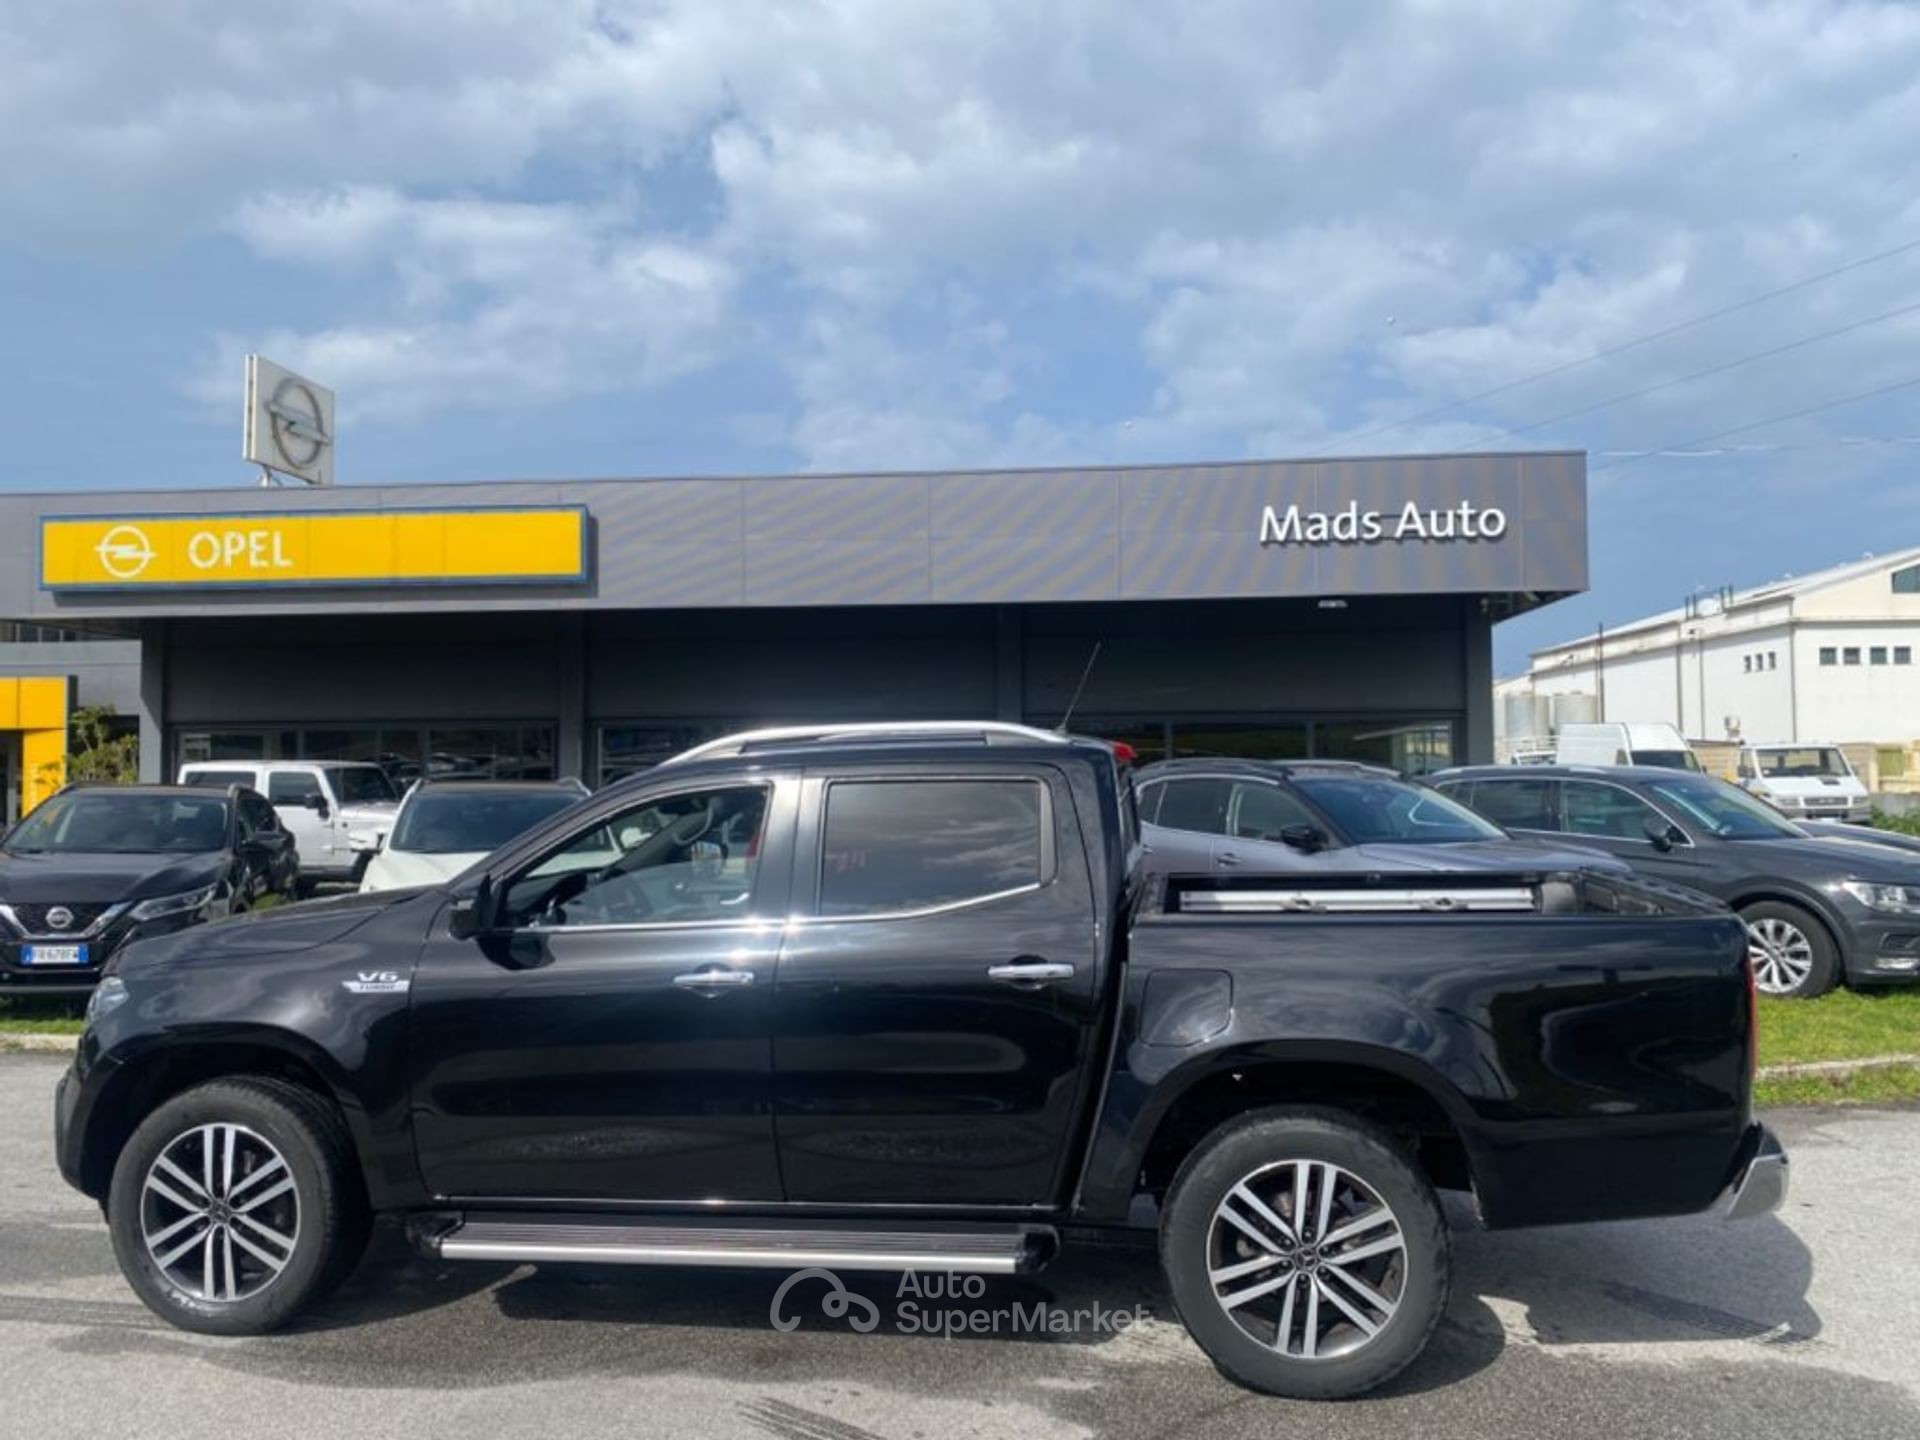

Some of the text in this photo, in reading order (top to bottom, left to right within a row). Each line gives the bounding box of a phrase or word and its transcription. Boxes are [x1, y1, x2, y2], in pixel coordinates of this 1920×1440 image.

[1260, 500, 1506, 542] Mads Auto
[188, 530, 293, 568] OPEL
[357, 971, 399, 981] V6
